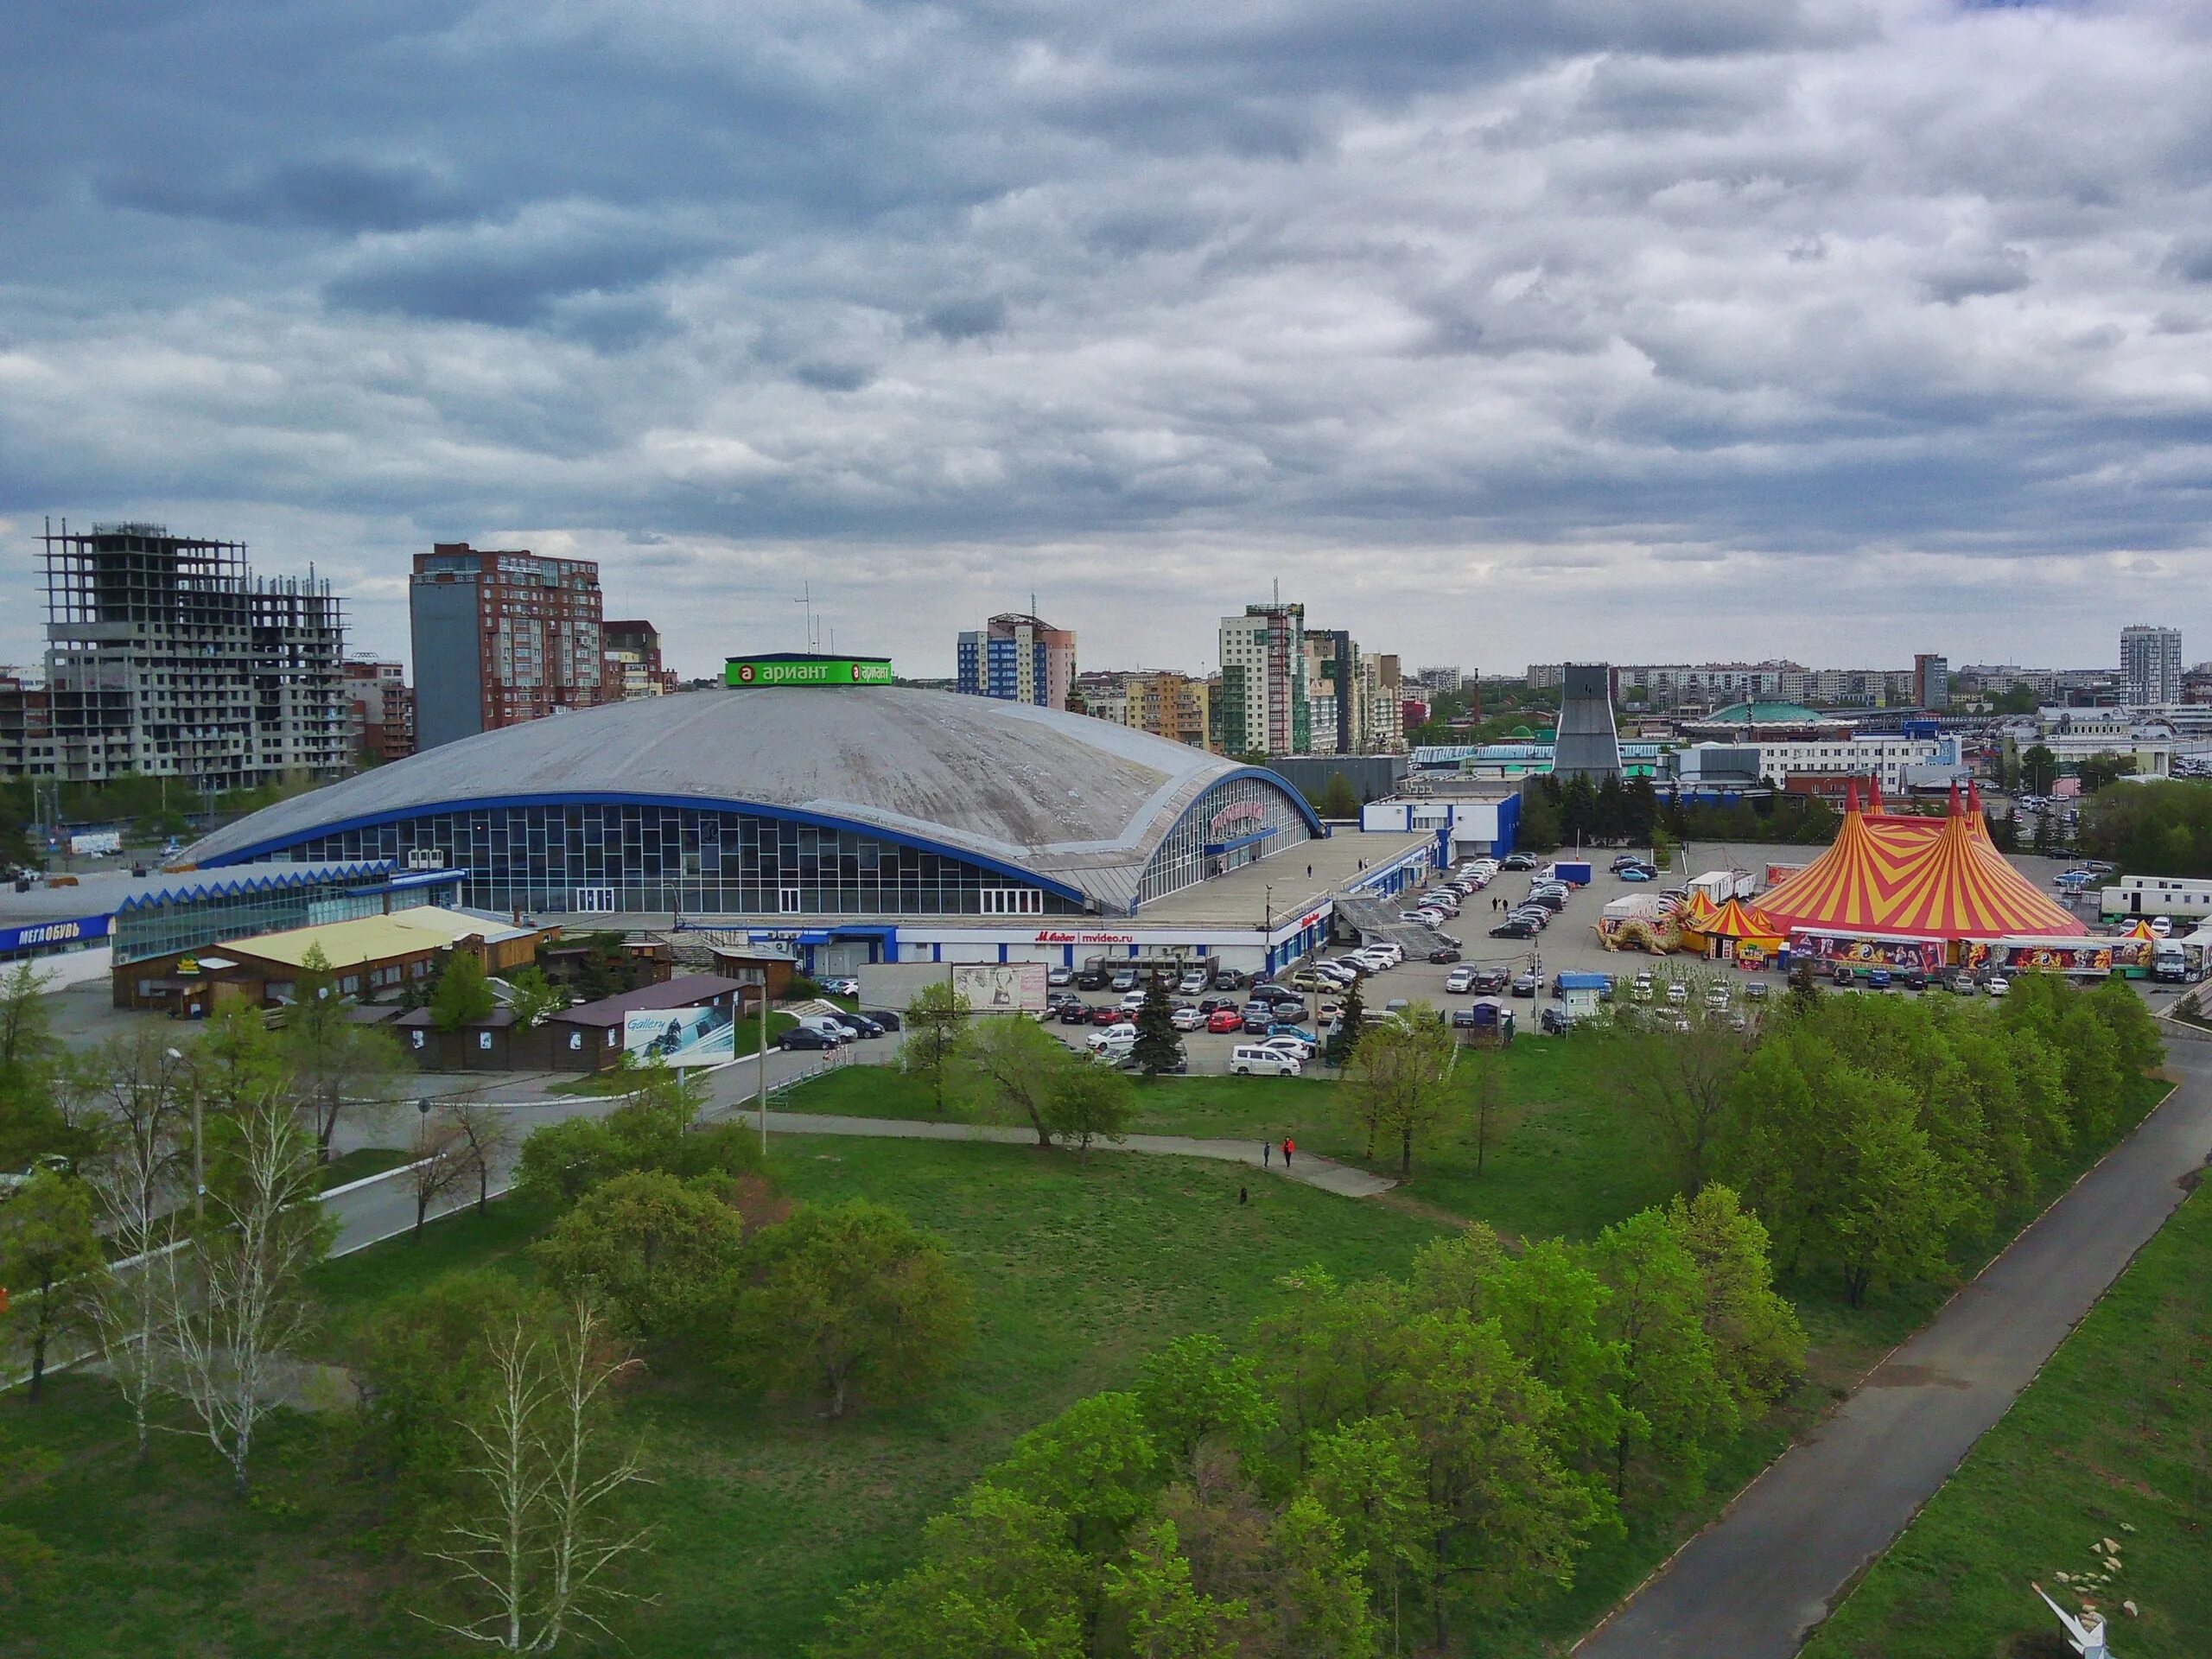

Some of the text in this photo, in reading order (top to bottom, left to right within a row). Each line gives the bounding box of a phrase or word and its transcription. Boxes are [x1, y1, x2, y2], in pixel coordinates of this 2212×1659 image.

[763, 665, 828, 683] ариант
[861, 666, 889, 682] ариант
[1082, 933, 1133, 943] mvideo.ru
[627, 1017, 665, 1032] Gallery
